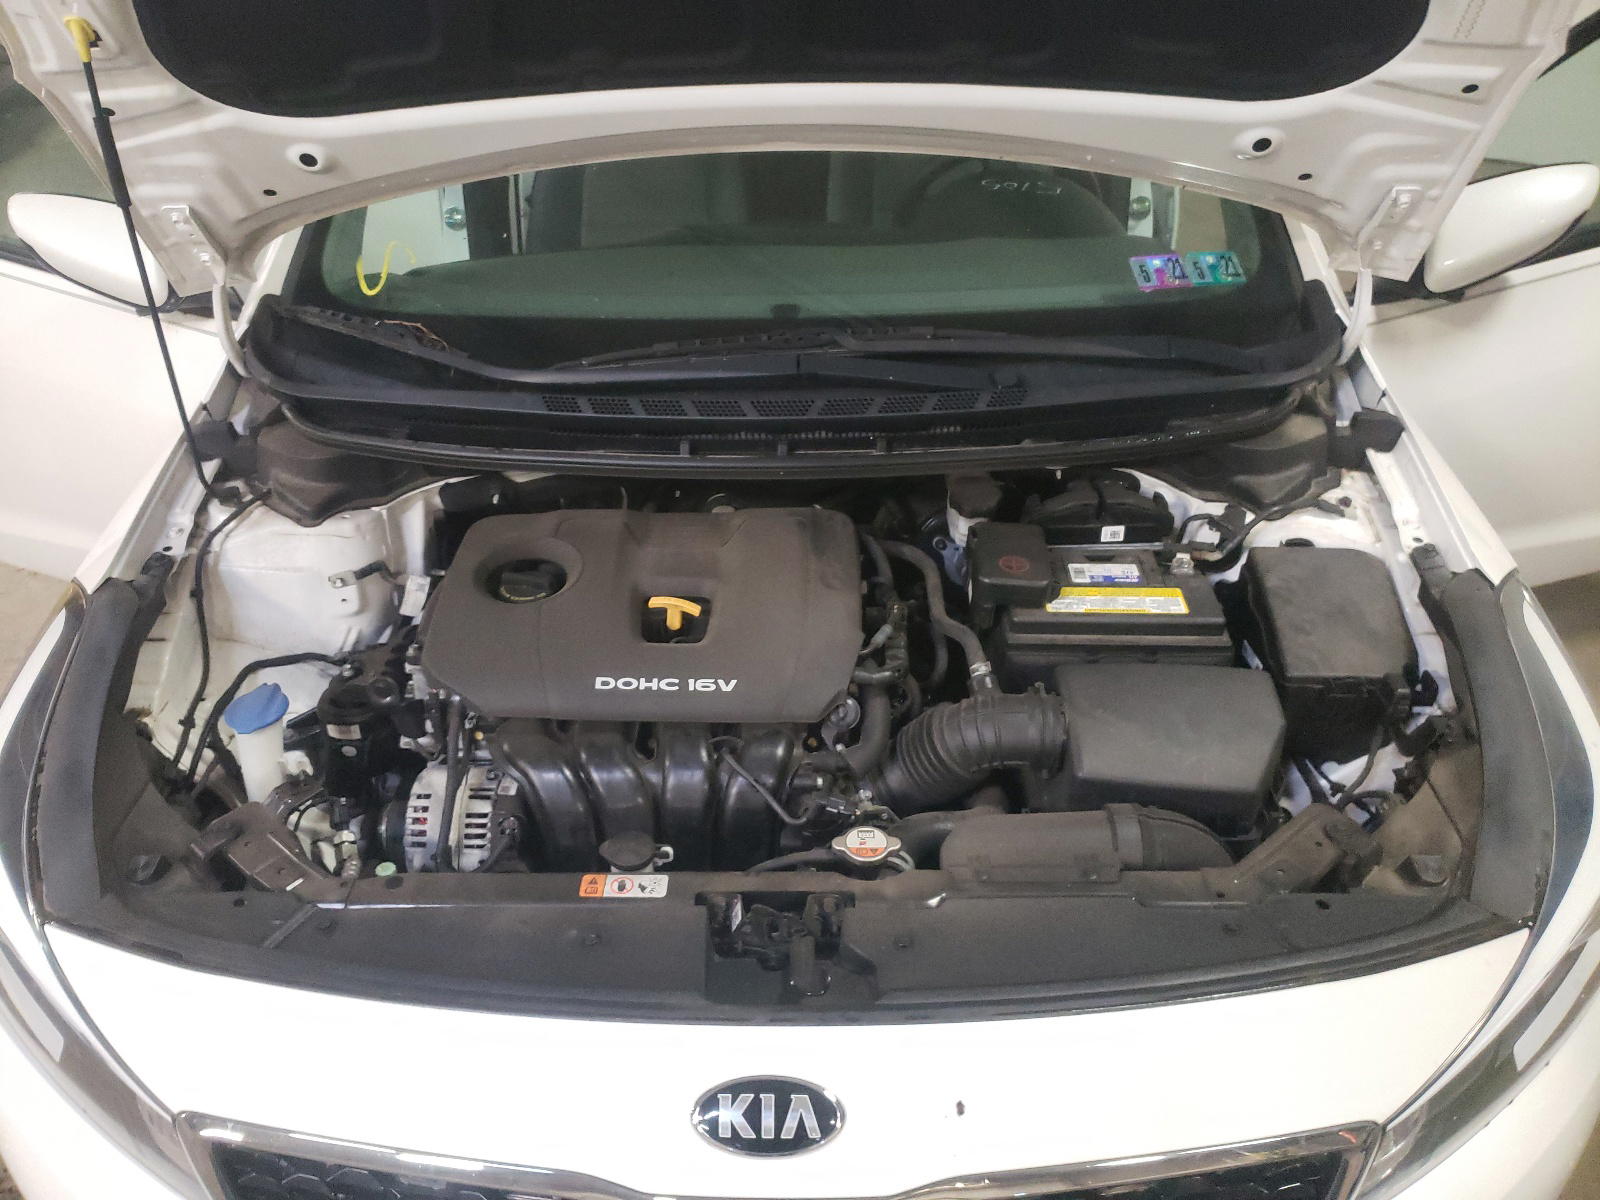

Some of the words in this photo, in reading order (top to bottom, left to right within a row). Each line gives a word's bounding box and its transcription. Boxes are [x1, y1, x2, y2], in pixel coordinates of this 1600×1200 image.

[1139, 264, 1151, 283] 5
[1166, 257, 1188, 279] 21
[1193, 261, 1206, 280] 5
[1217, 255, 1241, 277] 21
[594, 676, 680, 691] DOHC
[687, 678, 738, 692] 16V
[717, 1093, 821, 1139] KIA
